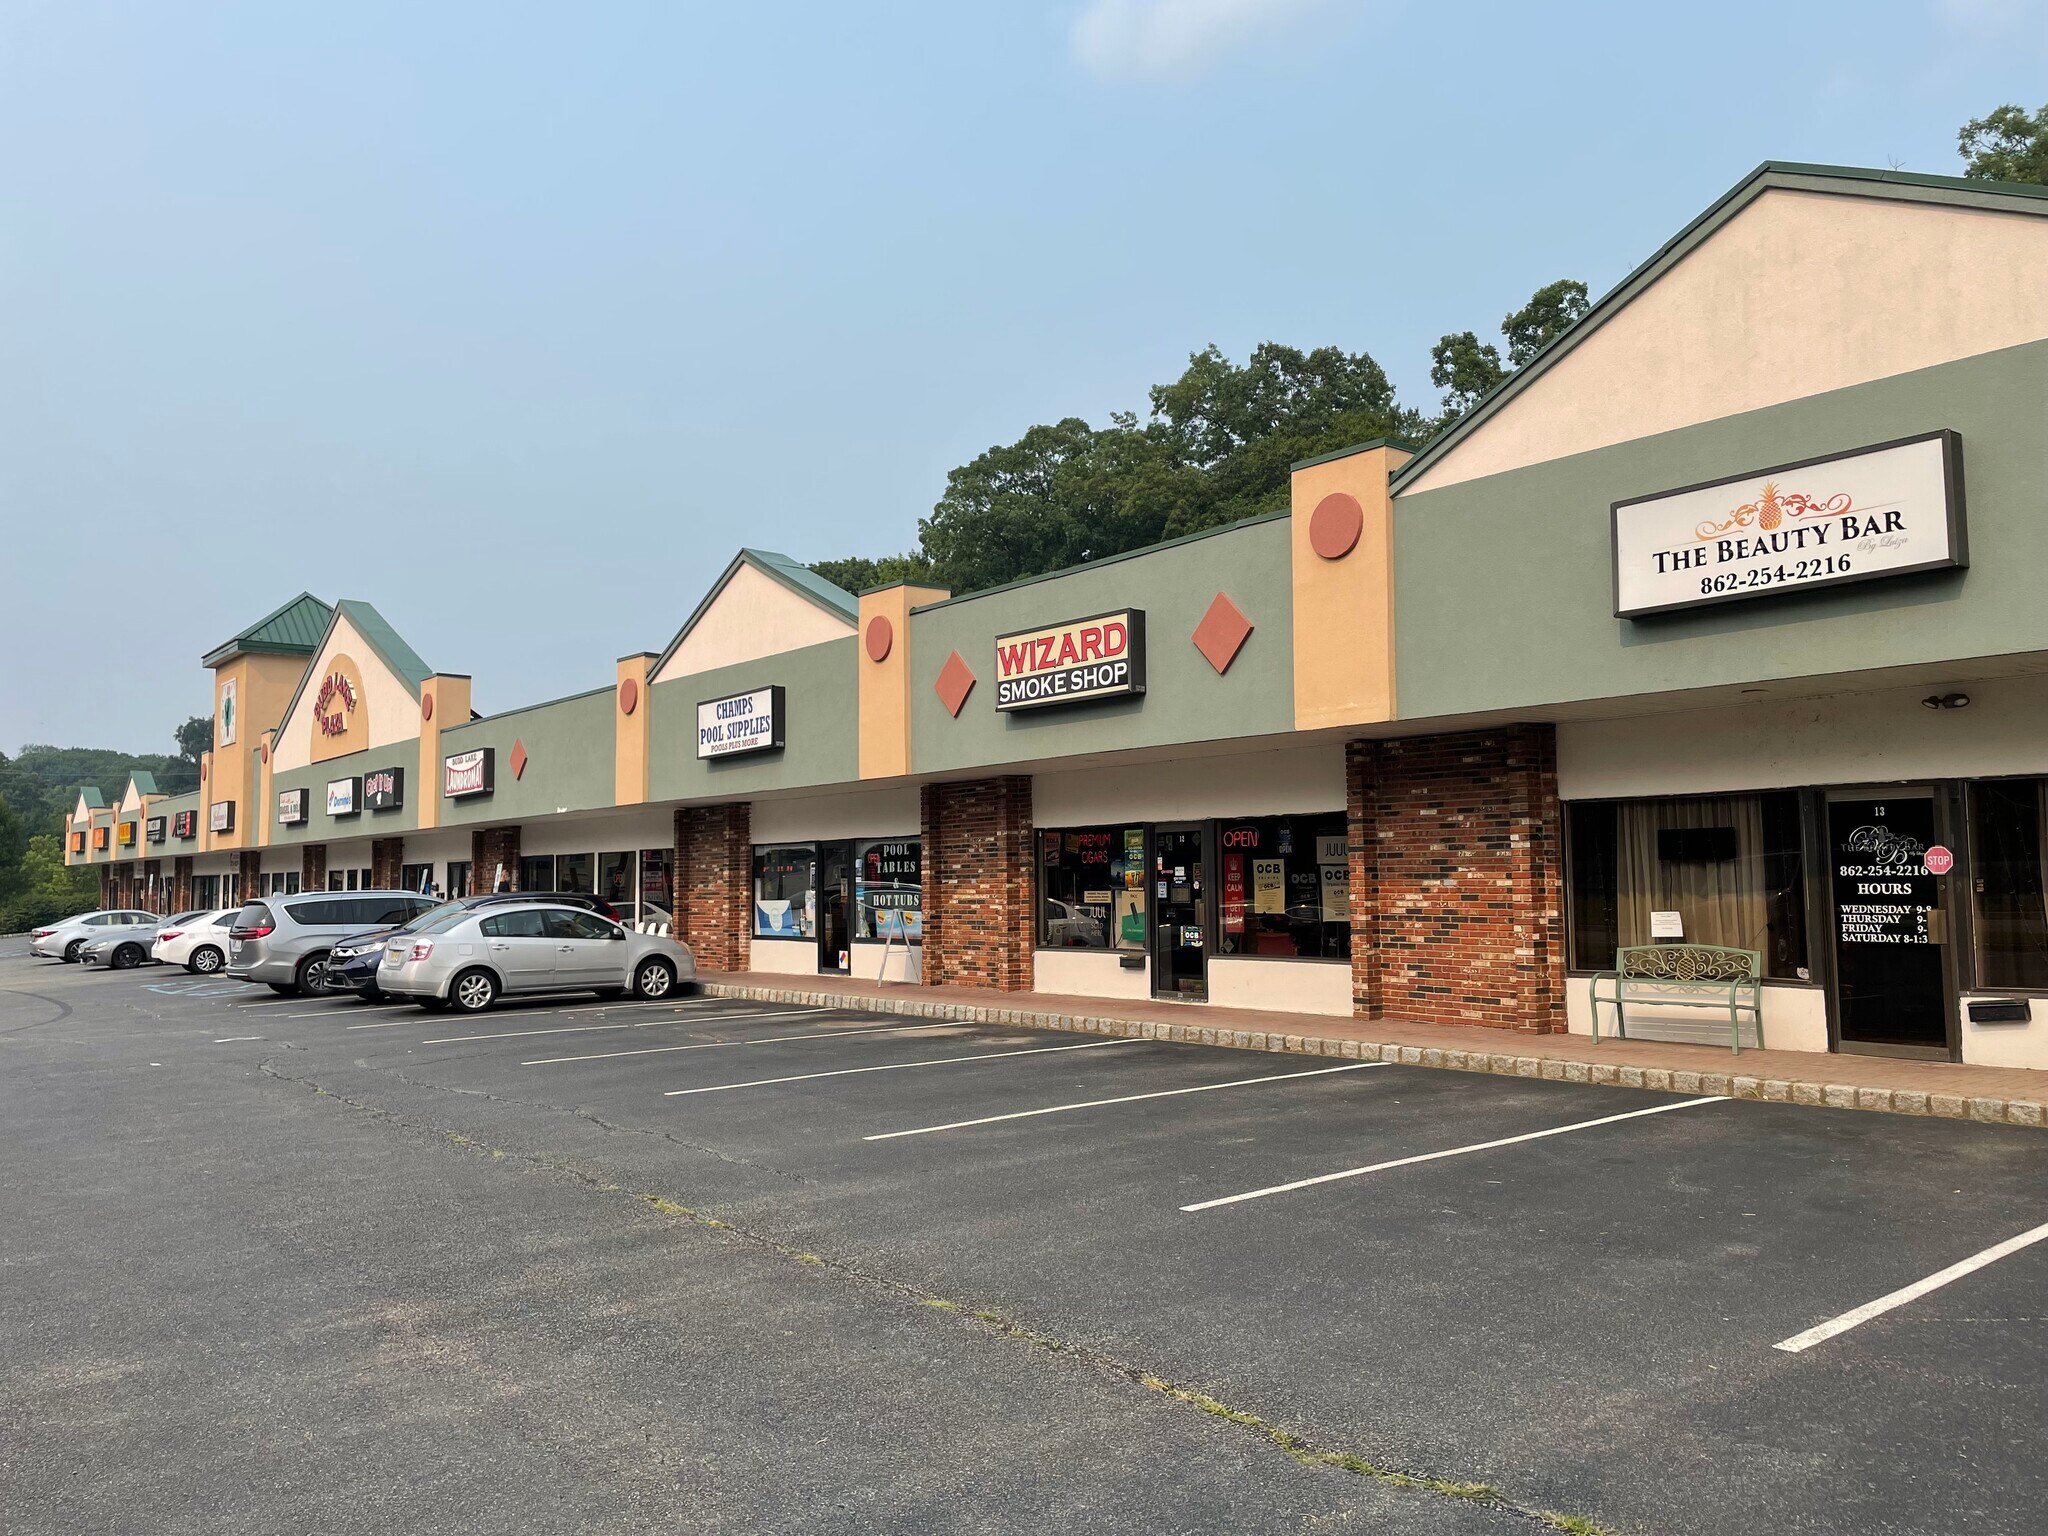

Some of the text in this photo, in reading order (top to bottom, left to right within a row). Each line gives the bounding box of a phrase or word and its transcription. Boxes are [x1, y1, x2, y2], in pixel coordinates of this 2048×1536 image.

[1652, 510, 1907, 574] THE BEAUTY BAR
[1857, 537, 1876, 554] By
[1700, 553, 1851, 595] 862-254-2216
[998, 622, 1127, 676] WIZARD
[1000, 662, 1127, 703] SMOKE SHOP
[314, 675, 333, 721] BUDD
[717, 696, 753, 720] CHAMPS
[322, 712, 343, 735] PLAZA
[700, 715, 770, 745] POOL SUPPLIES
[711, 737, 758, 753] POOLS PLUS MORE
[465, 753, 477, 763] LAKE
[447, 761, 482, 792] LAUNDROMAT
[1875, 806, 1885, 816] 13
[1079, 834, 1110, 846] PREMIUM
[1223, 831, 1259, 847] OPEN
[883, 843, 910, 857] POOL
[1081, 850, 1108, 864] CIGARS
[1927, 856, 1950, 866] STOP
[876, 861, 916, 873] TABLES
[1256, 864, 1281, 874] OCB
[1840, 865, 1928, 876] 862-254-2216
[1228, 872, 1241, 881] KEEP
[1291, 873, 1317, 884] OCB
[1325, 870, 1350, 880] OCB
[893, 877, 899, 889] &
[1226, 884, 1243, 892] CALM
[1857, 883, 1912, 895] HOURS
[873, 894, 919, 907] HOT TUBS
[1841, 905, 1911, 913] WEDNESDAY
[1841, 915, 1901, 923] THURSDAY
[1842, 924, 1882, 933] FRIDAY
[1184, 931, 1199, 939] OCB
[1842, 934, 1901, 943] SATURDAY
